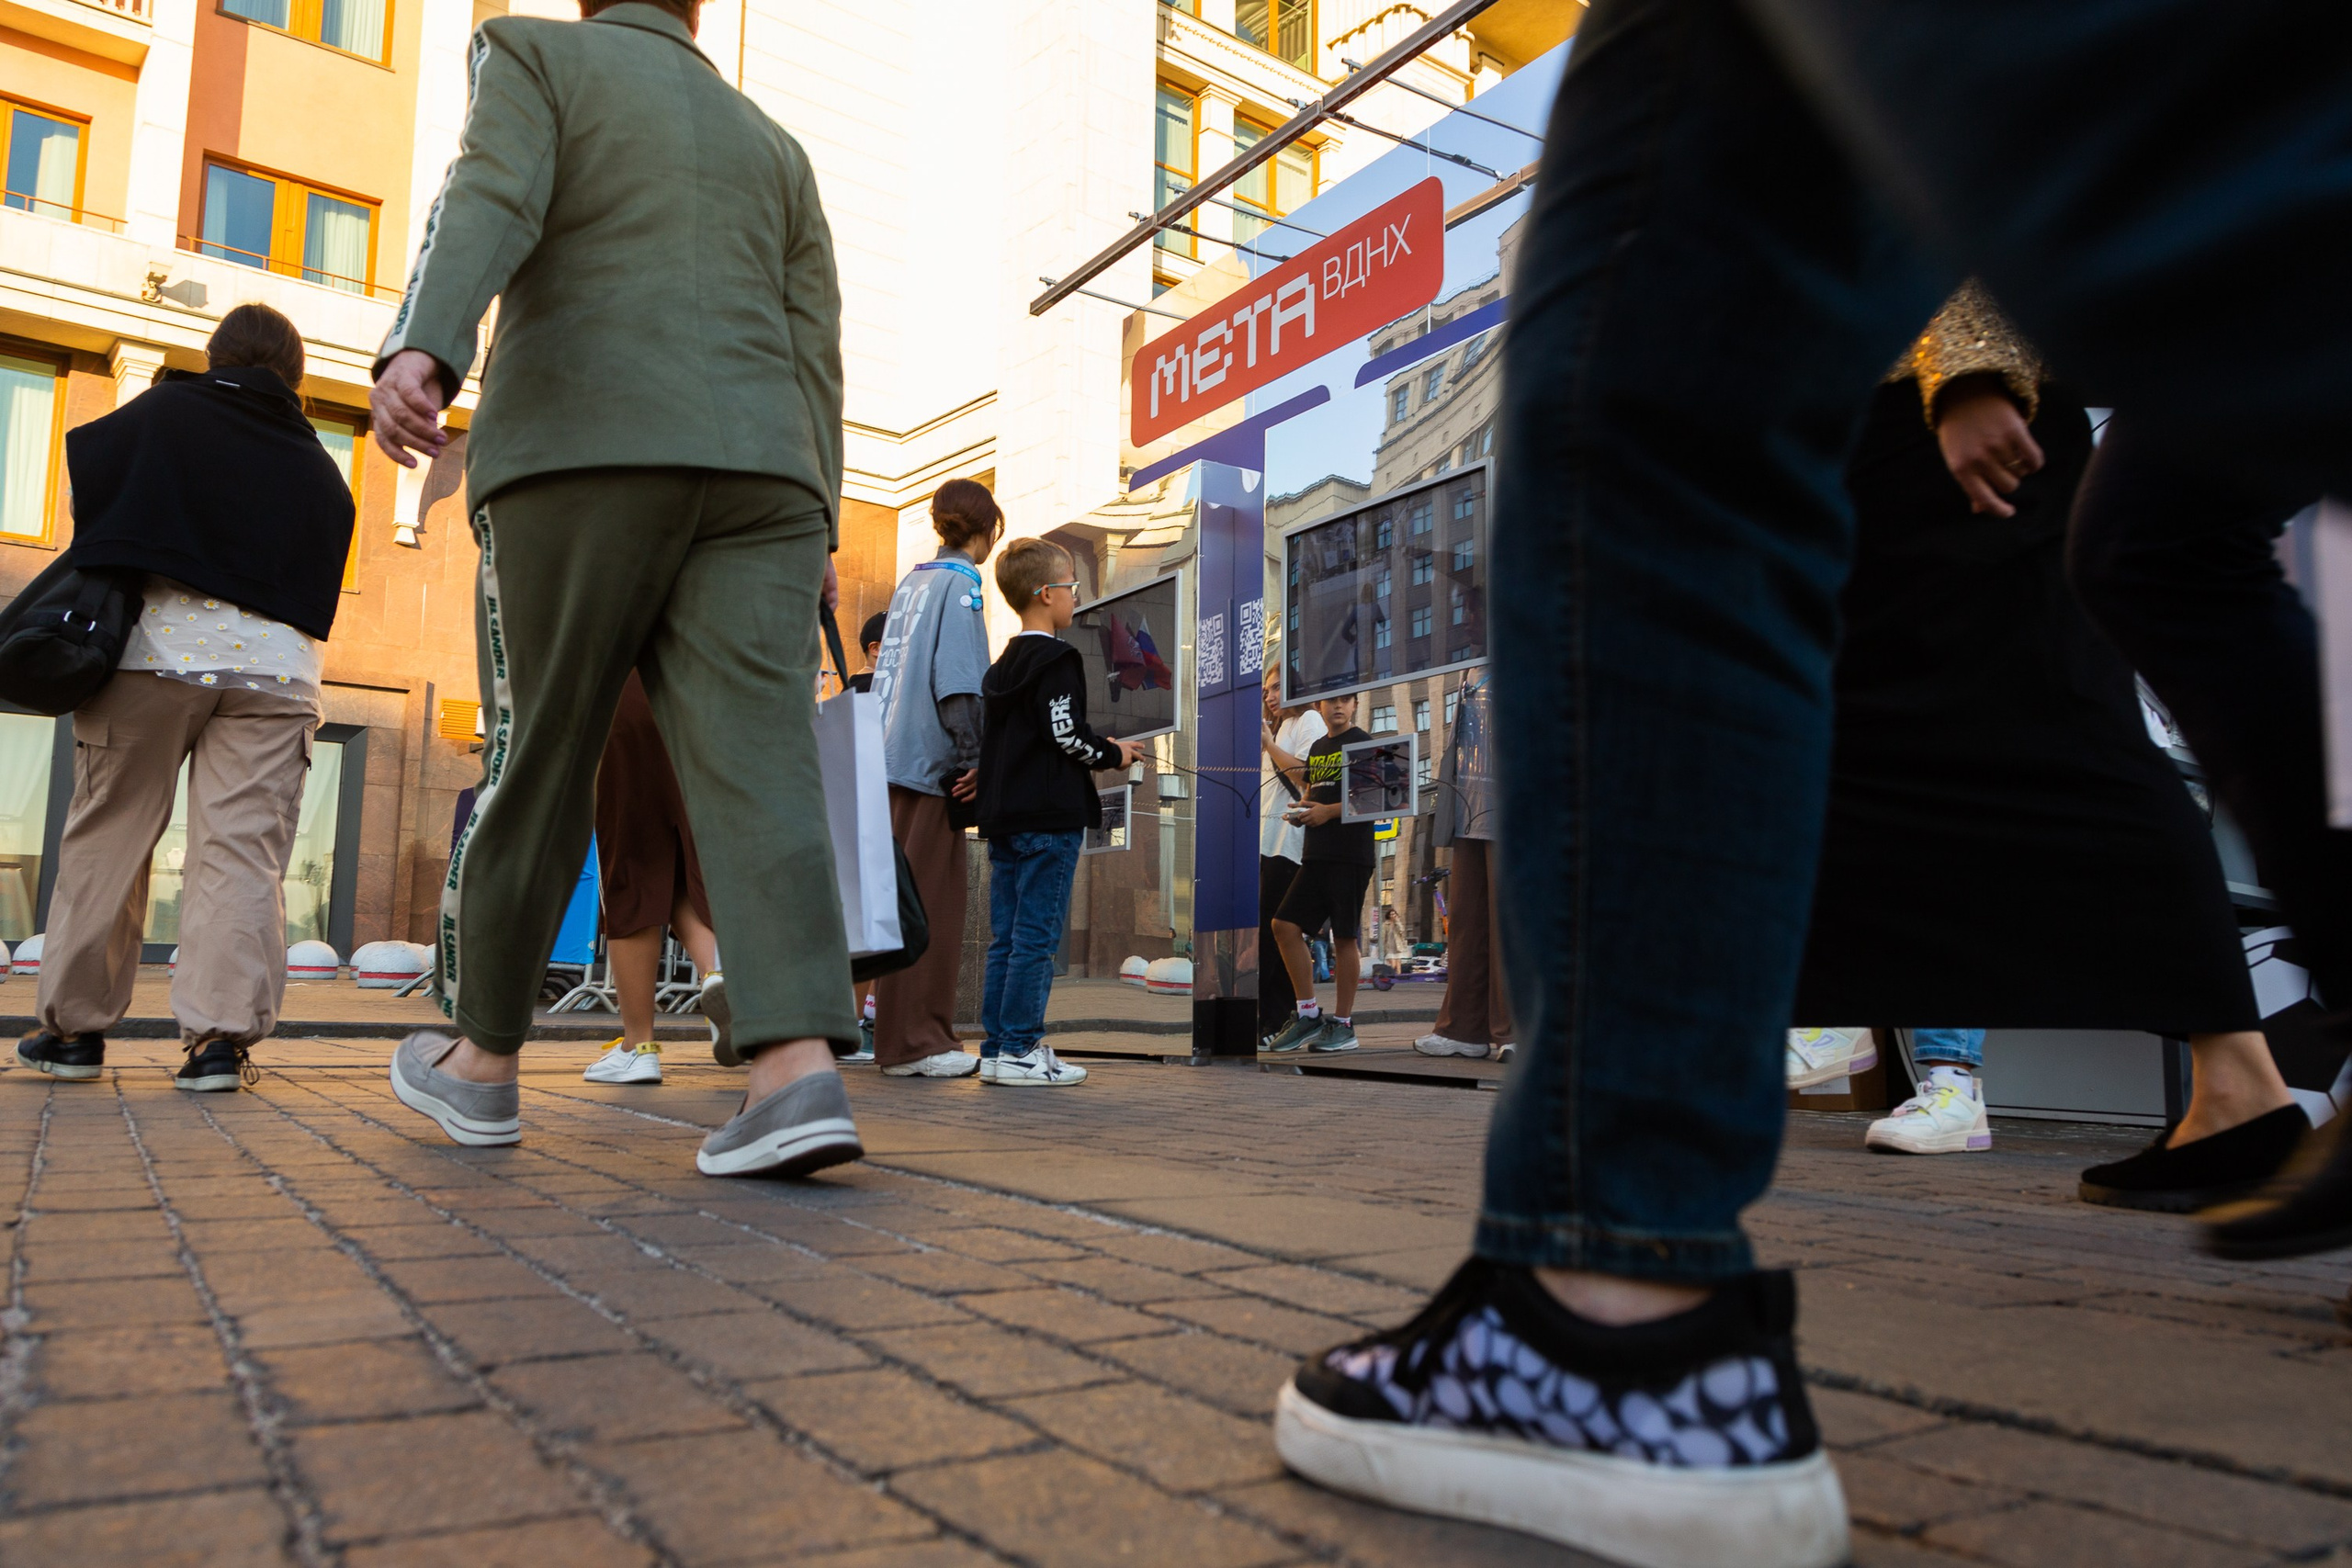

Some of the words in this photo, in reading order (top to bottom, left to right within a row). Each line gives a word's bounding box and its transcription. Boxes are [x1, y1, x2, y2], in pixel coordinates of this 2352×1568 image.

[1322, 212, 1412, 300] ВДНХ
[477, 506, 492, 566] ANDER
[486, 594, 497, 615] JIL
[490, 616, 505, 679] SANDER
[499, 706, 510, 726] JIL
[490, 727, 508, 786] SANDER
[447, 829, 469, 890] SANDER
[444, 931, 456, 983] SANDER
